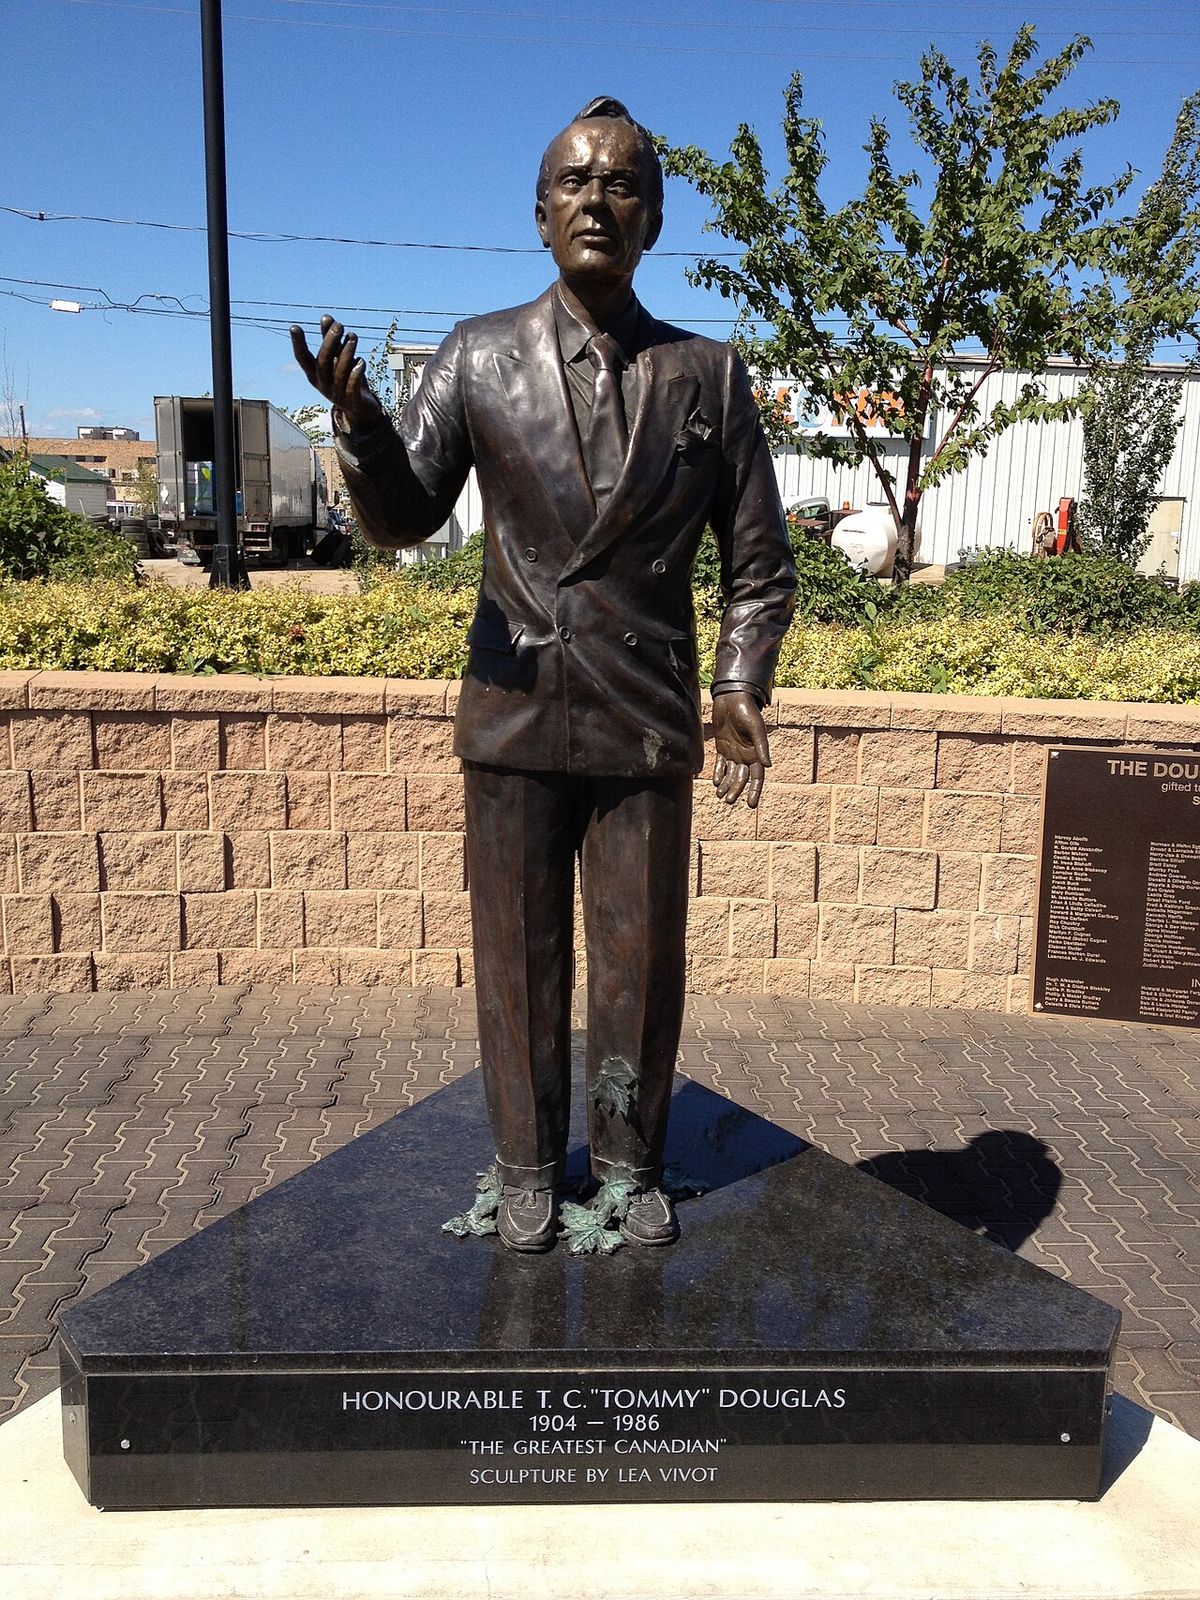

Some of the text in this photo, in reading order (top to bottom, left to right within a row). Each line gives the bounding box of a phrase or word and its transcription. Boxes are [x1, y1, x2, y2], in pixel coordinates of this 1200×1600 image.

[1107, 759, 1200, 780] THE DOU
[1161, 781, 1192, 793] gifted
[342, 1387, 847, 1411] HONOURABLE T. C. "TOMMY" DOUGLAS
[529, 1414, 578, 1433] 1904
[613, 1413, 661, 1432] 1986
[460, 1437, 728, 1456] "THE GREATEST CANADIAN"
[470, 1466, 719, 1486] SCULPTURE BY LEA VIVOT
